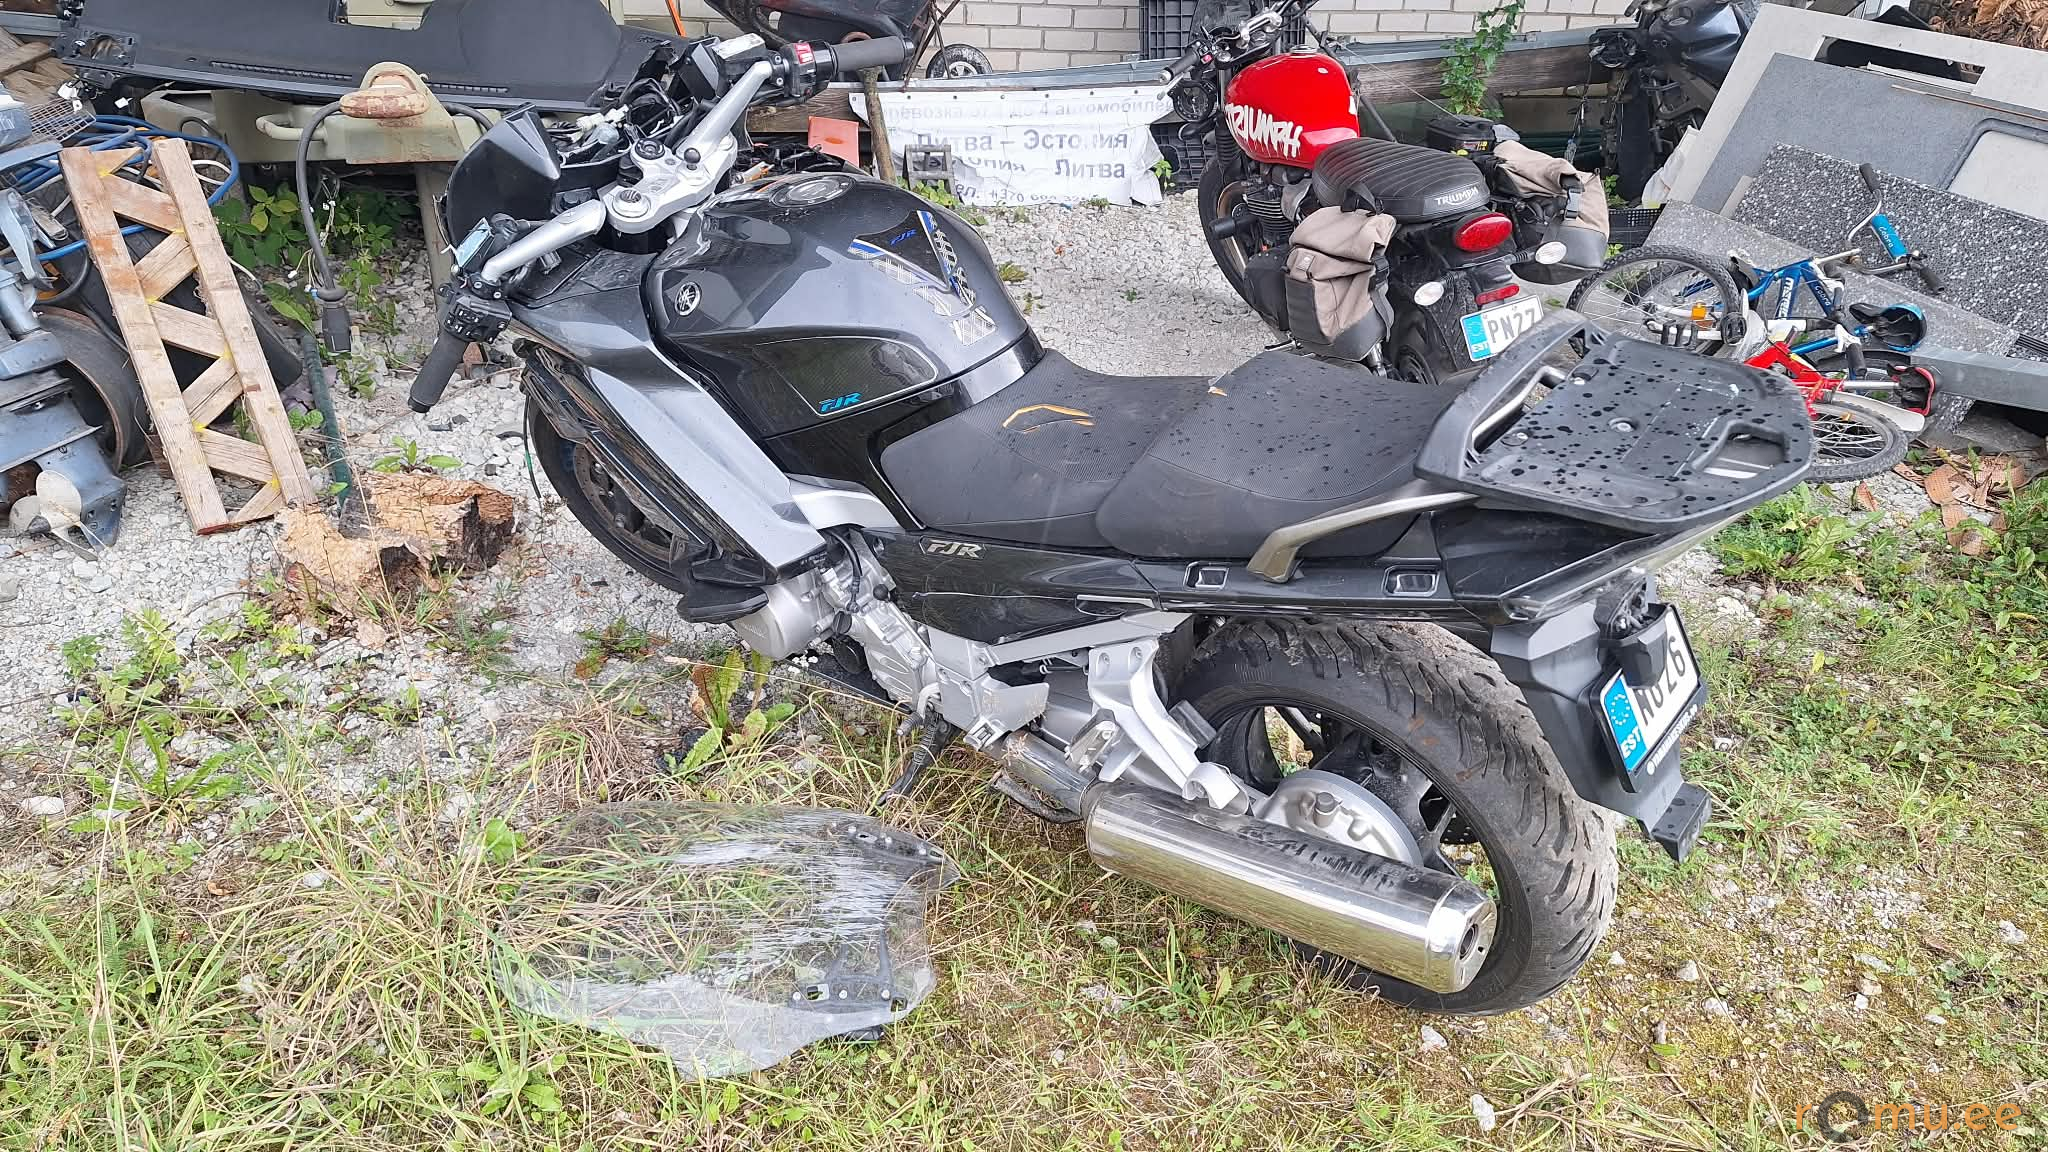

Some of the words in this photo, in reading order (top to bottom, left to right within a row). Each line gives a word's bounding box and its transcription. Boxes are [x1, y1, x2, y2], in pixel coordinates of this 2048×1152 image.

[1040, 101, 1049, 116] 4
[1225, 103, 1303, 158] TRIUMPH
[1053, 158, 1126, 179] Литва
[955, 182, 981, 199] ел.
[1434, 186, 1479, 205] TRIUMPH
[1877, 225, 1895, 248] Cobra
[819, 392, 862, 412] FJR
[927, 539, 983, 558] FJR
[1620, 725, 1643, 760] EST
